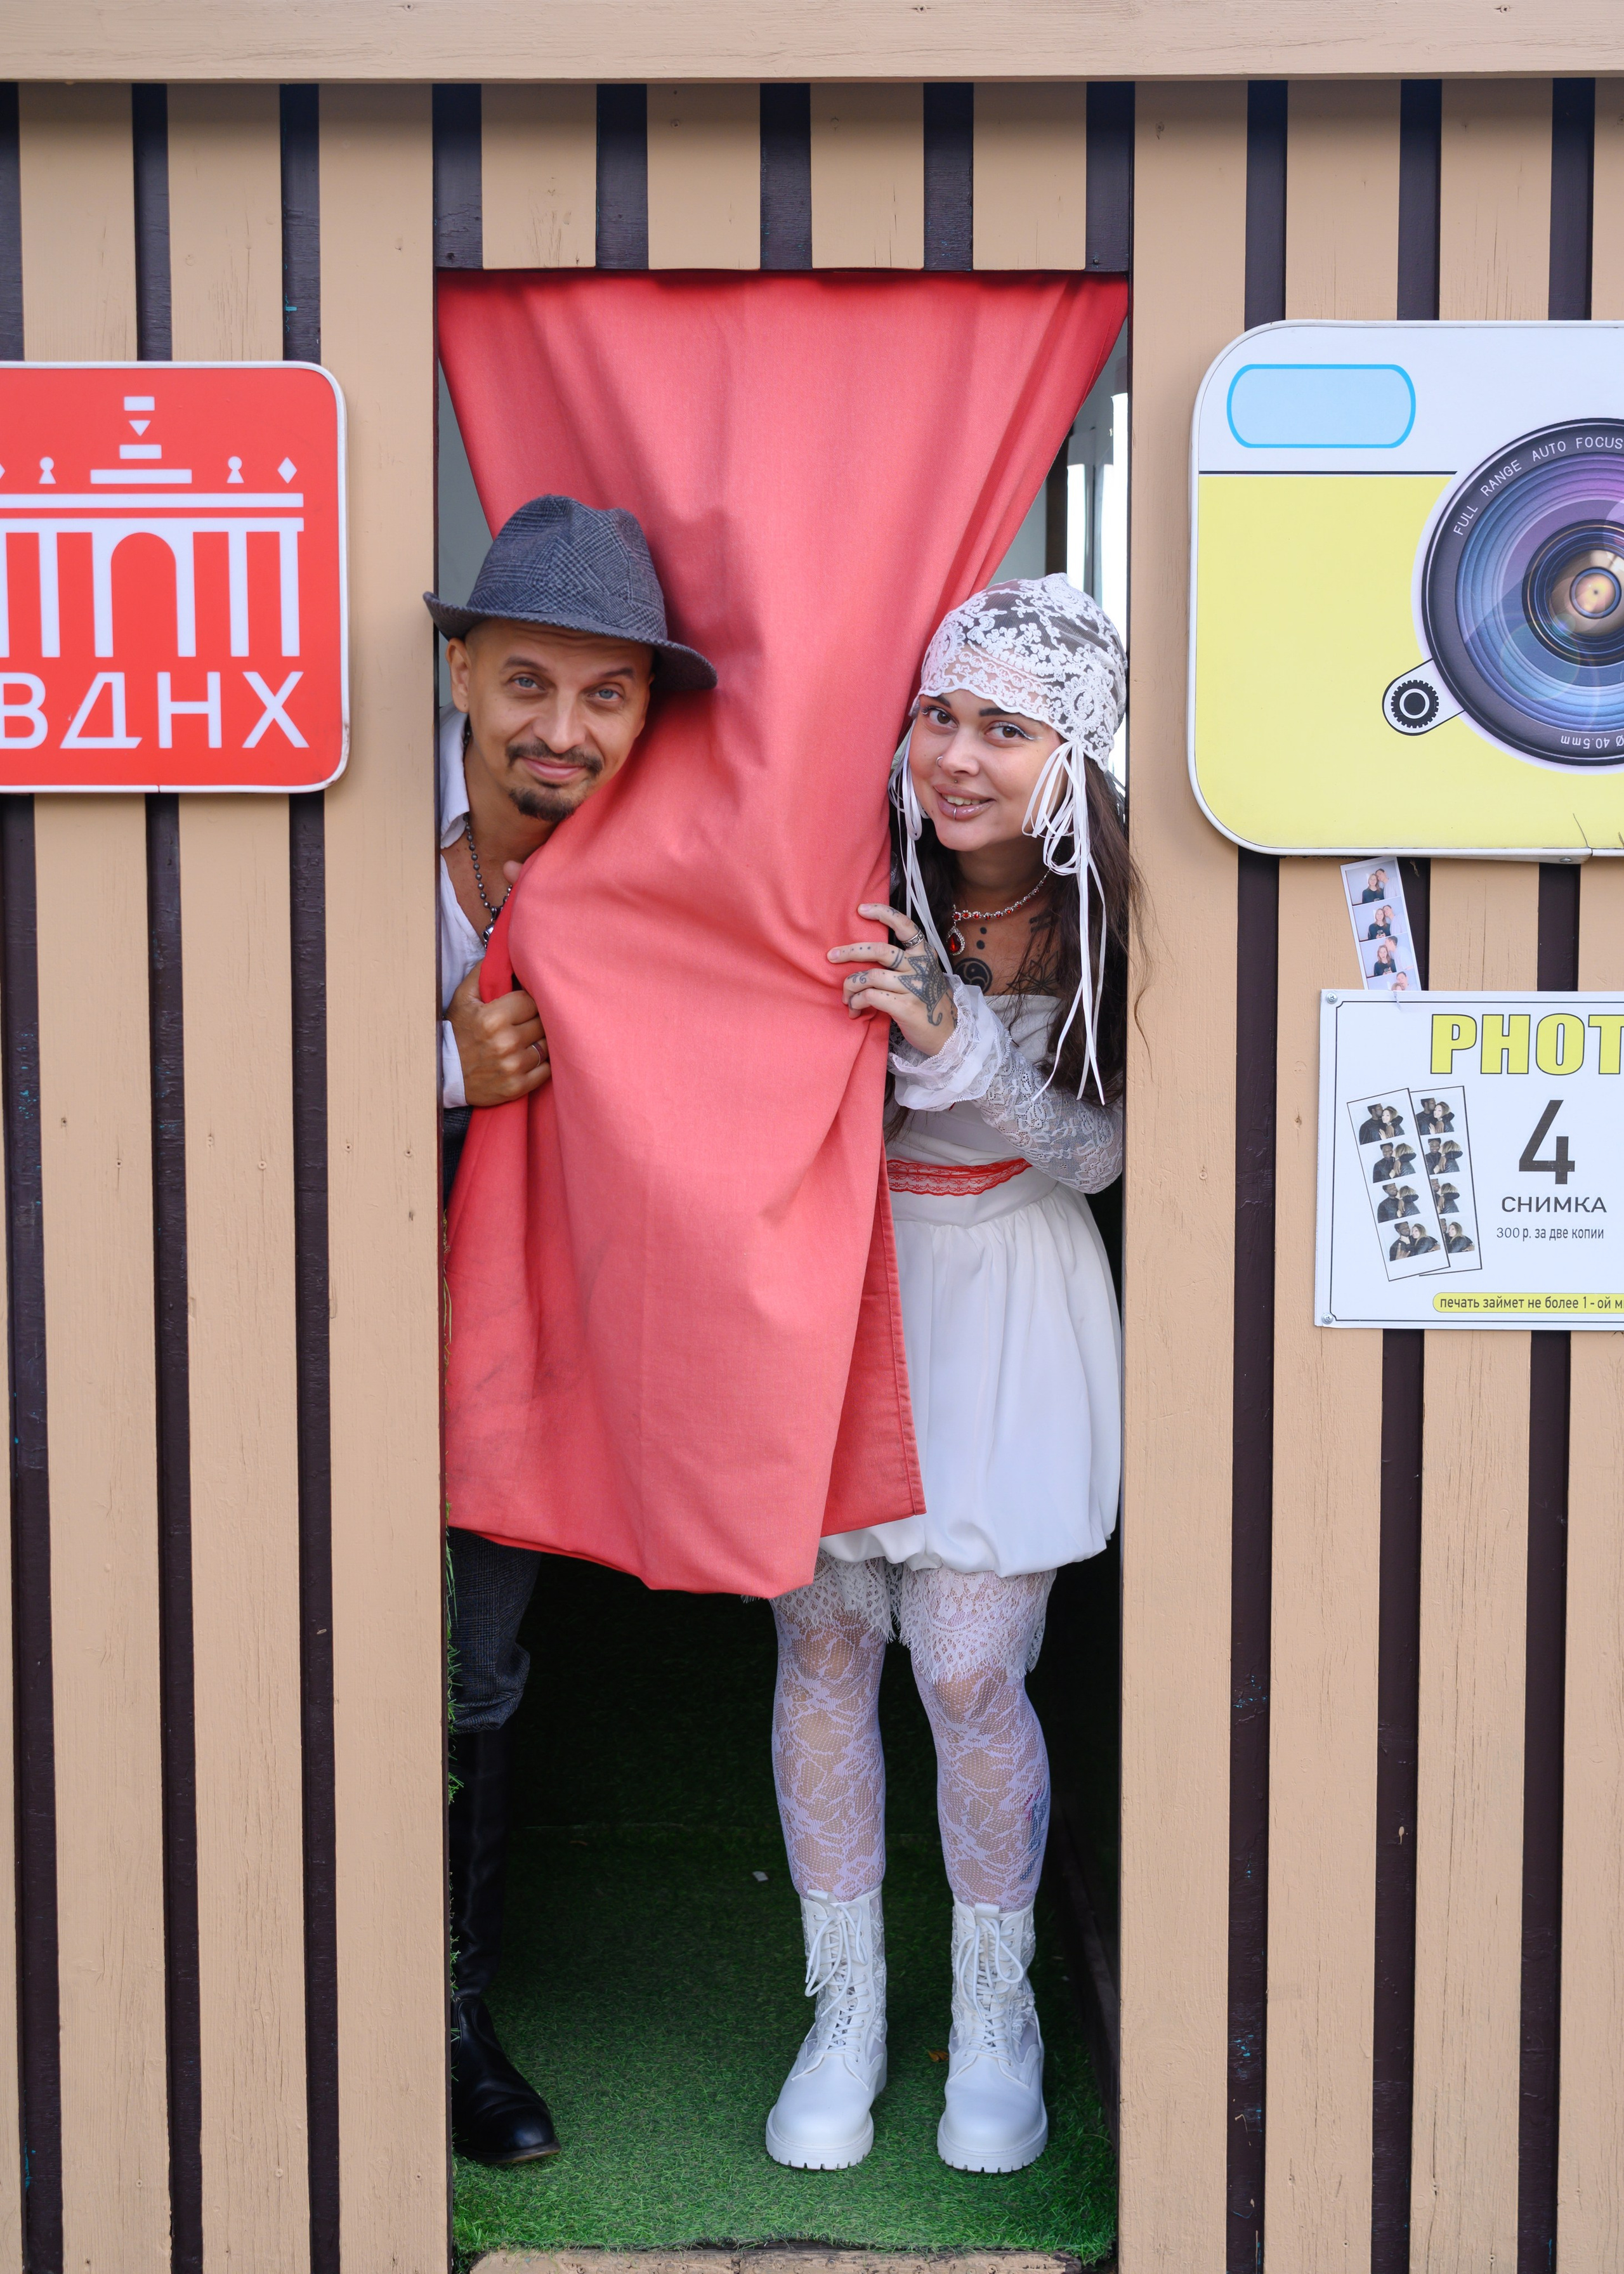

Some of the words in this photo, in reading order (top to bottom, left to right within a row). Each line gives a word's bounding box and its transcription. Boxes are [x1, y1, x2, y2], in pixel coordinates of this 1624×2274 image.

[1453, 505, 1479, 535] FULL
[1480, 459, 1522, 497] RANGE
[1531, 441, 1566, 462] AUTO
[1576, 436, 1623, 449] FOCUS
[0, 671, 310, 750] ВДНХ
[1561, 735, 1611, 749] 40.5mm
[1430, 1012, 1624, 1076] PHOT
[1518, 1099, 1576, 1186] 4
[1502, 1196, 1608, 1213] СНИМКА
[1496, 1227, 1520, 1238] 300
[1522, 1228, 1531, 1242] р.
[1535, 1228, 1546, 1239] за
[1549, 1229, 1568, 1241] две
[1571, 1229, 1604, 1239] копии
[1440, 1298, 1480, 1308] печать
[1483, 1296, 1524, 1309] займет
[1528, 1299, 1542, 1309] не
[1545, 1297, 1579, 1309] более
[1614, 1300, 1624, 1309] м
